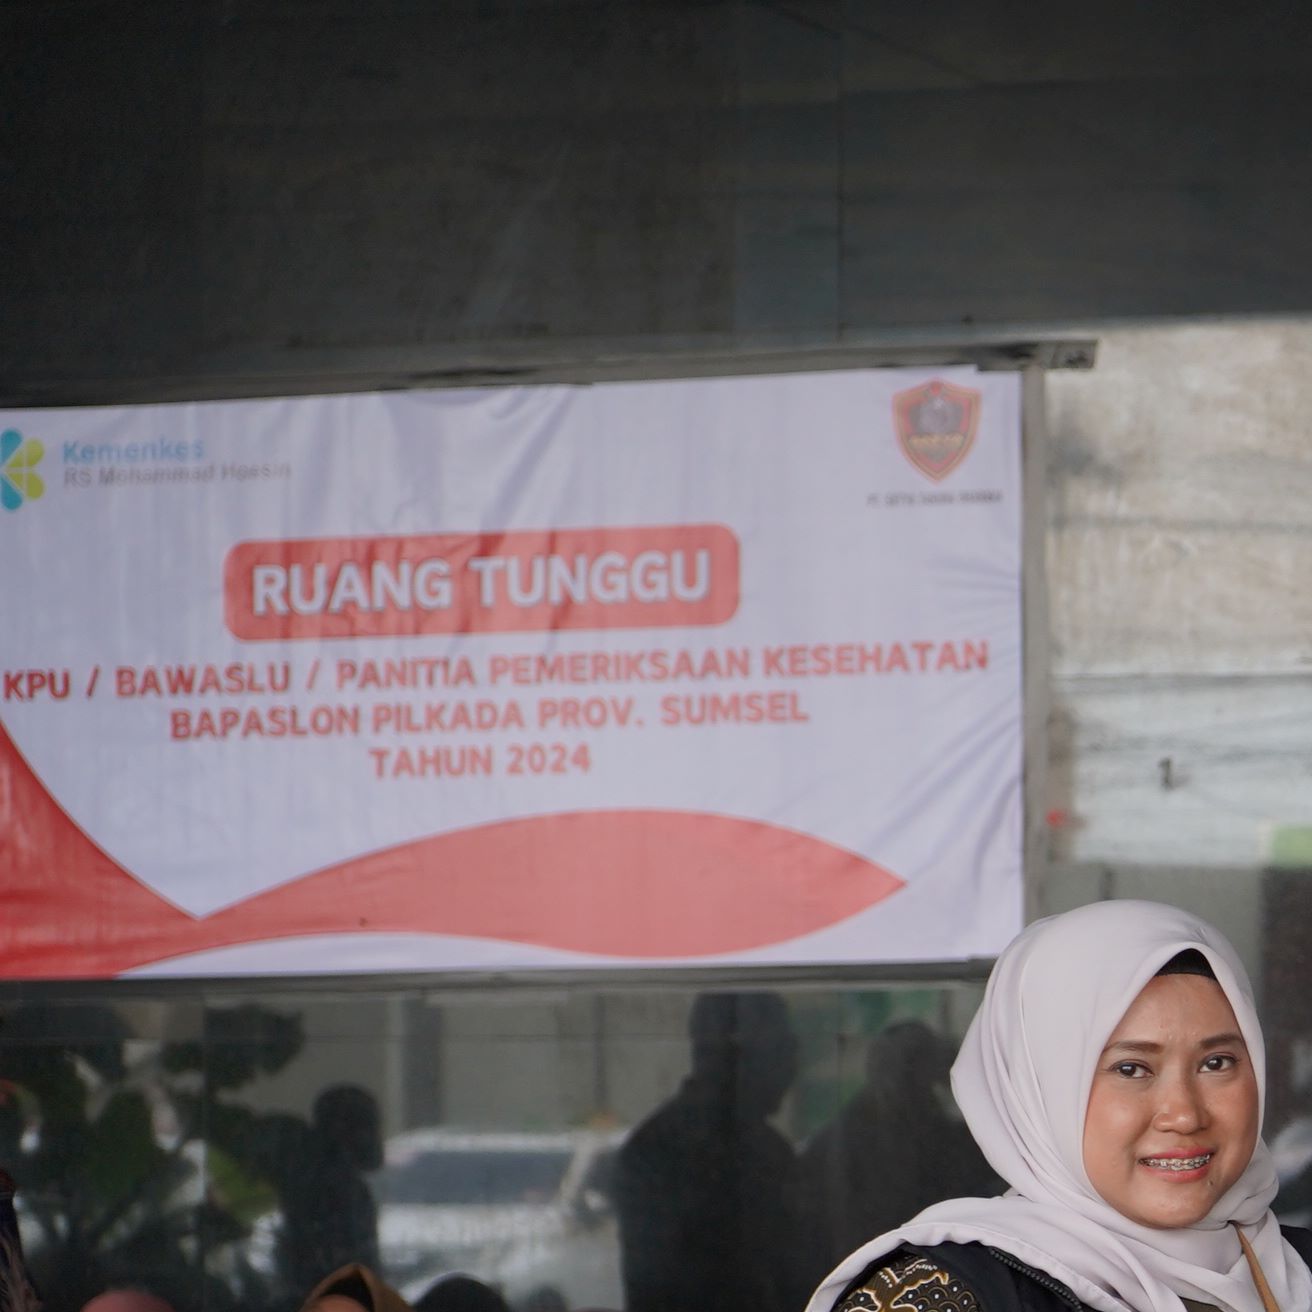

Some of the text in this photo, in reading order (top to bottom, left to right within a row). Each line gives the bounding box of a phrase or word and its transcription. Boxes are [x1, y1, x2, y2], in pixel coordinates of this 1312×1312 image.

[63, 437, 206, 464] Kemenkes
[64, 467, 92, 488] RS
[252, 551, 711, 614] RUANG TUNGGU
[3, 641, 989, 700] KPU / BAWASLU / PANITIA PEMERIKSAAN KESEHATAN
[170, 691, 810, 741] BAPASLON PILKADA PROV. SUMSEL
[369, 742, 591, 778] TAHUN 2024
